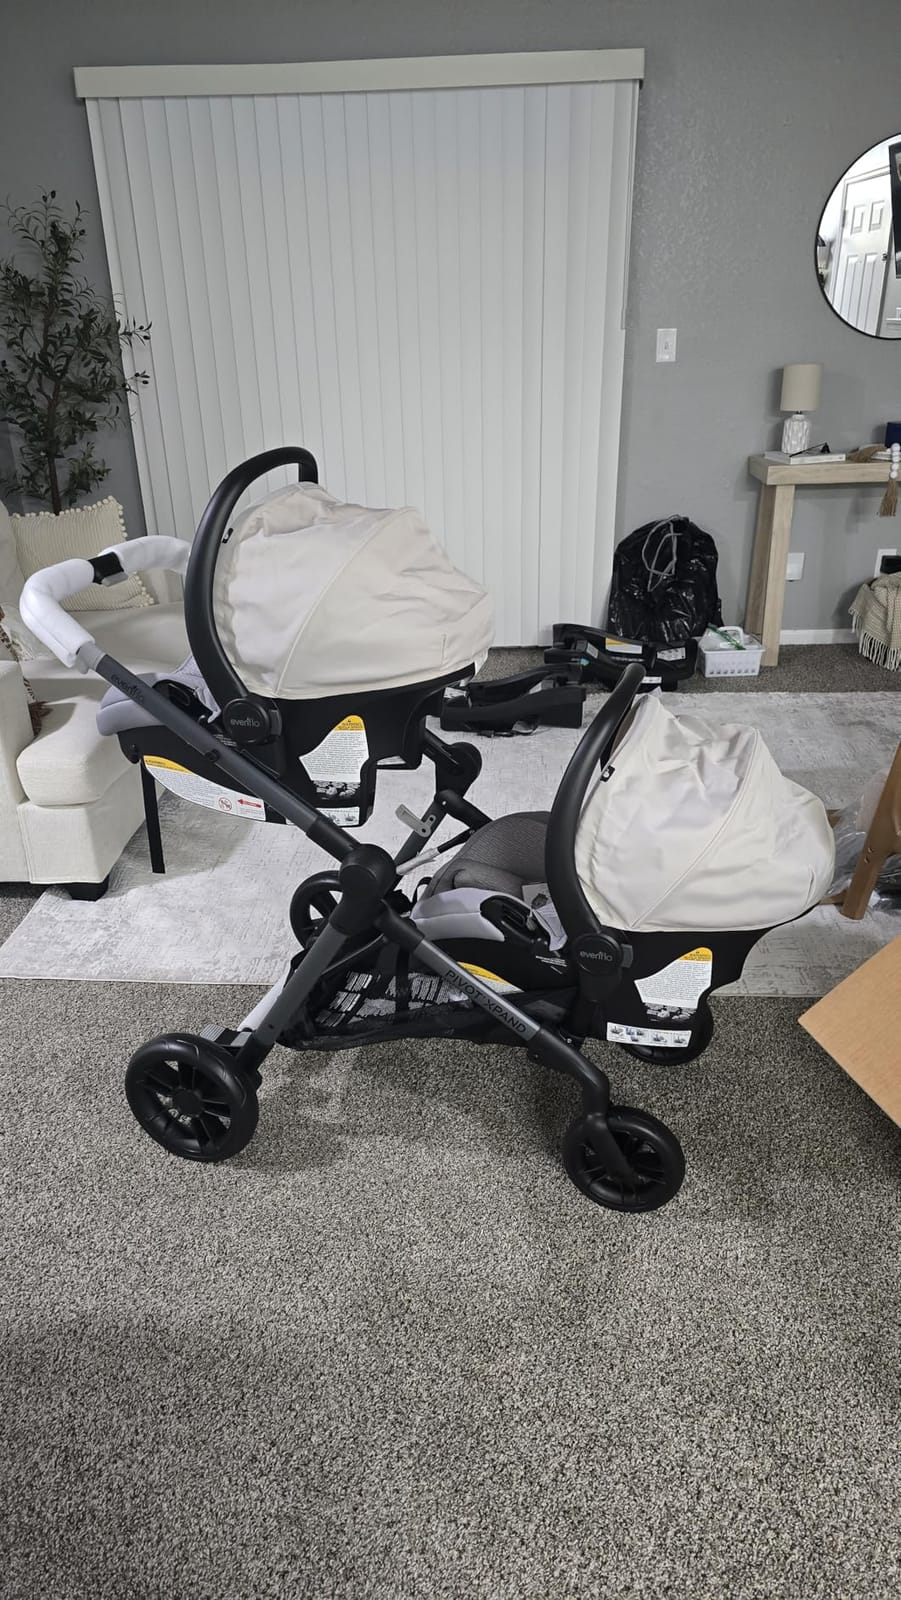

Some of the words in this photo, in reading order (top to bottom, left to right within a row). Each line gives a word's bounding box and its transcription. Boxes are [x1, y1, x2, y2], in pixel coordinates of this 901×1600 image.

[110, 674, 144, 703] evenflo
[230, 717, 260, 728] evenflo
[579, 951, 613, 962] evenflo
[445, 970, 482, 999] PIVOT
[483, 999, 526, 1033] XPAND
